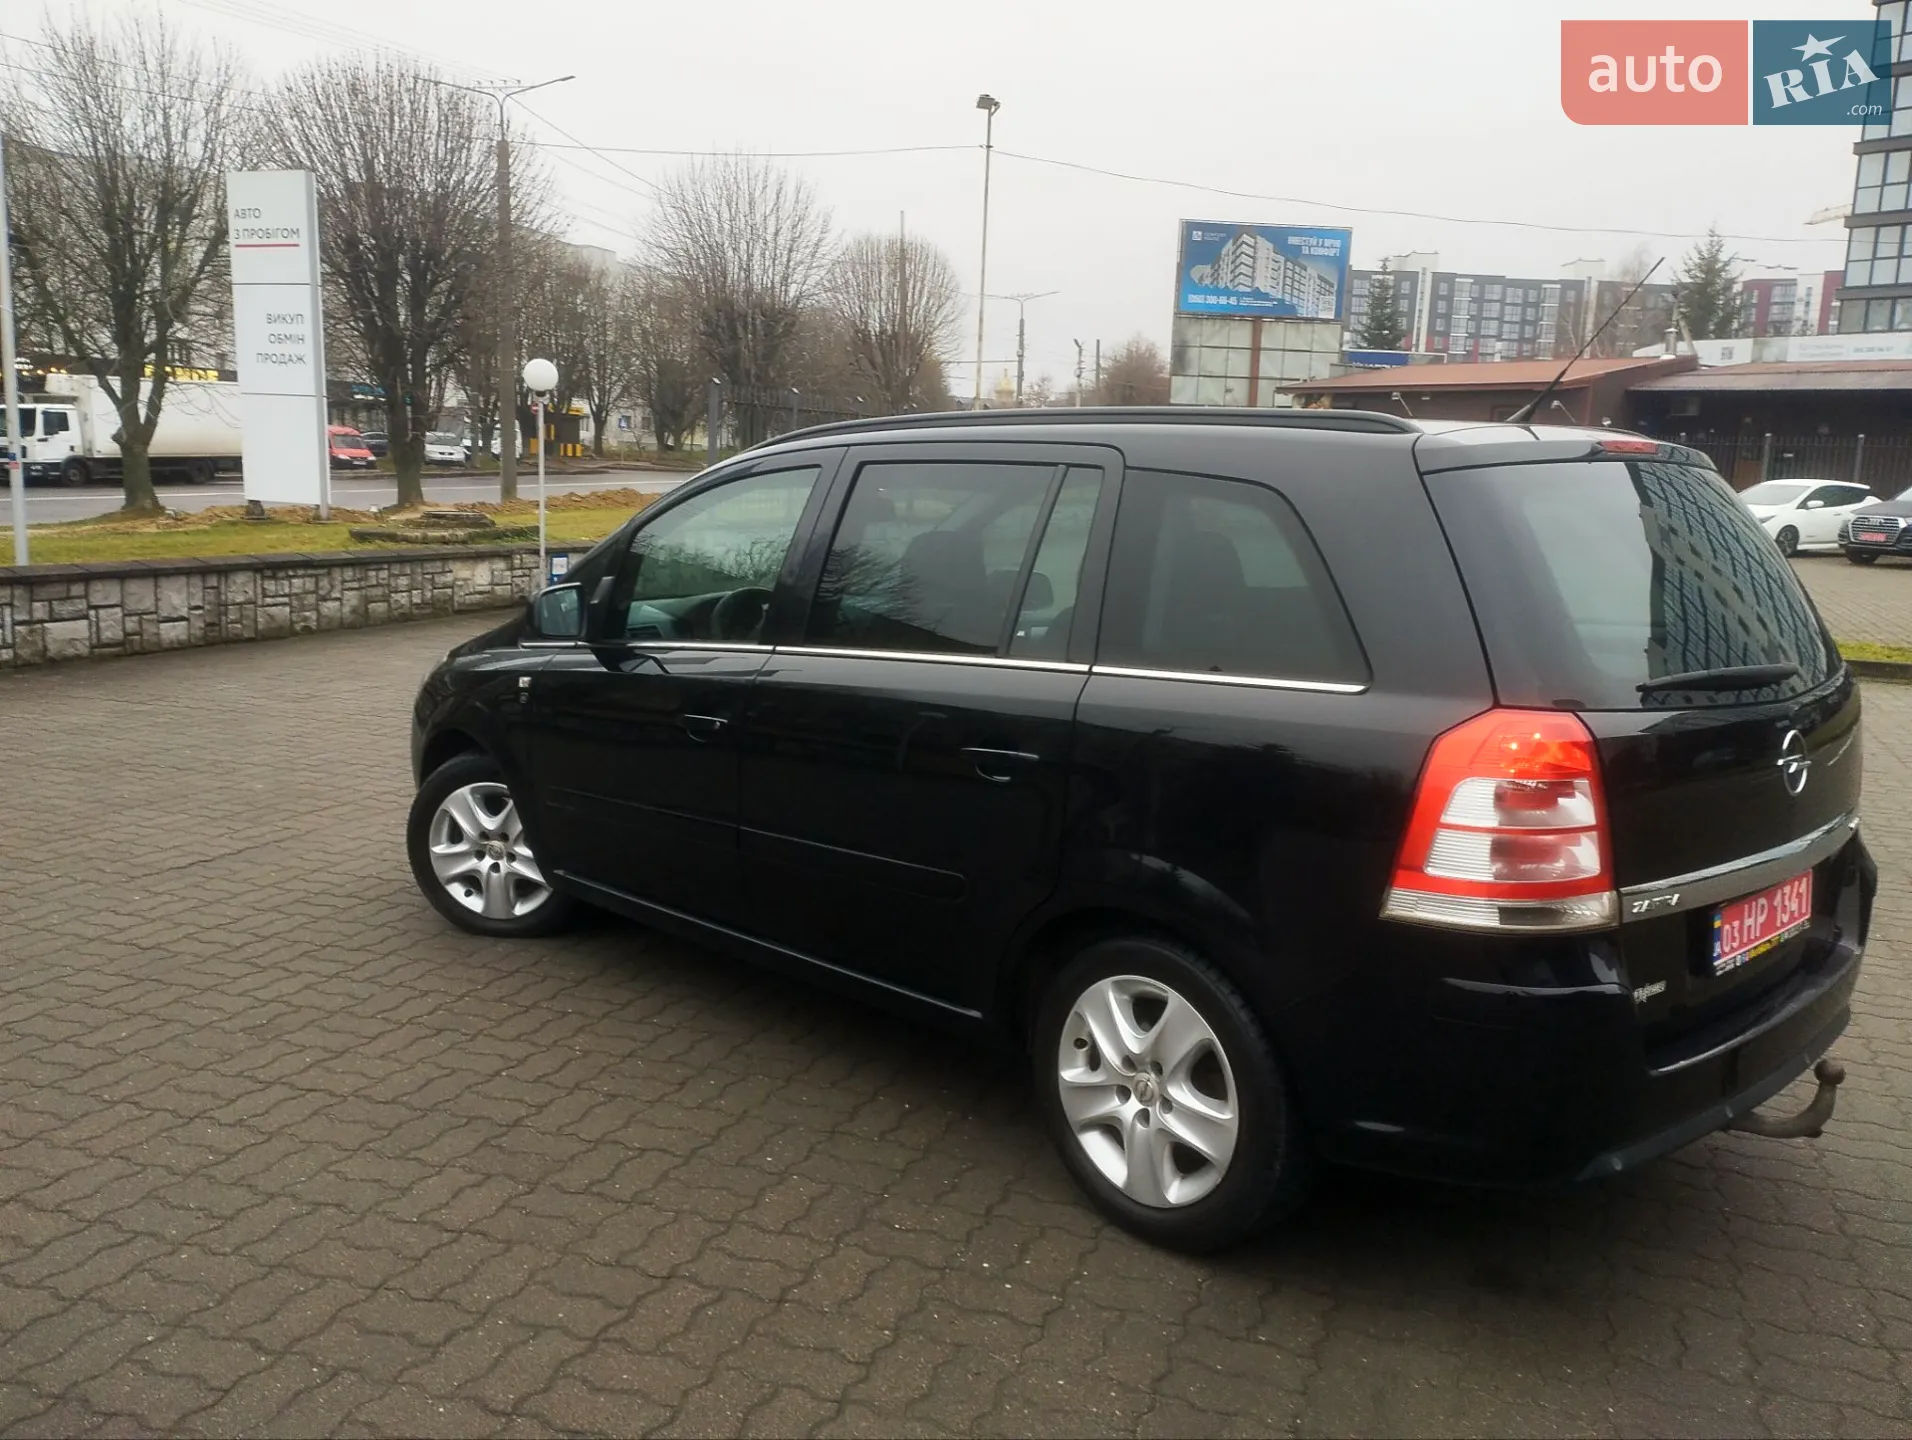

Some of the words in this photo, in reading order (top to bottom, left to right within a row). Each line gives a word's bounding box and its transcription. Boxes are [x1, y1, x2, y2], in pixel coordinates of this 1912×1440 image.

[234, 208, 261, 219] АВТО
[242, 228, 300, 239] ПРОБІГОМ
[266, 313, 304, 324] ВИКУП
[268, 333, 305, 344] ОБМІН
[256, 352, 306, 367] ПРОДАЖ
[1722, 920, 1741, 953] 03
[1743, 897, 1769, 943] HP
